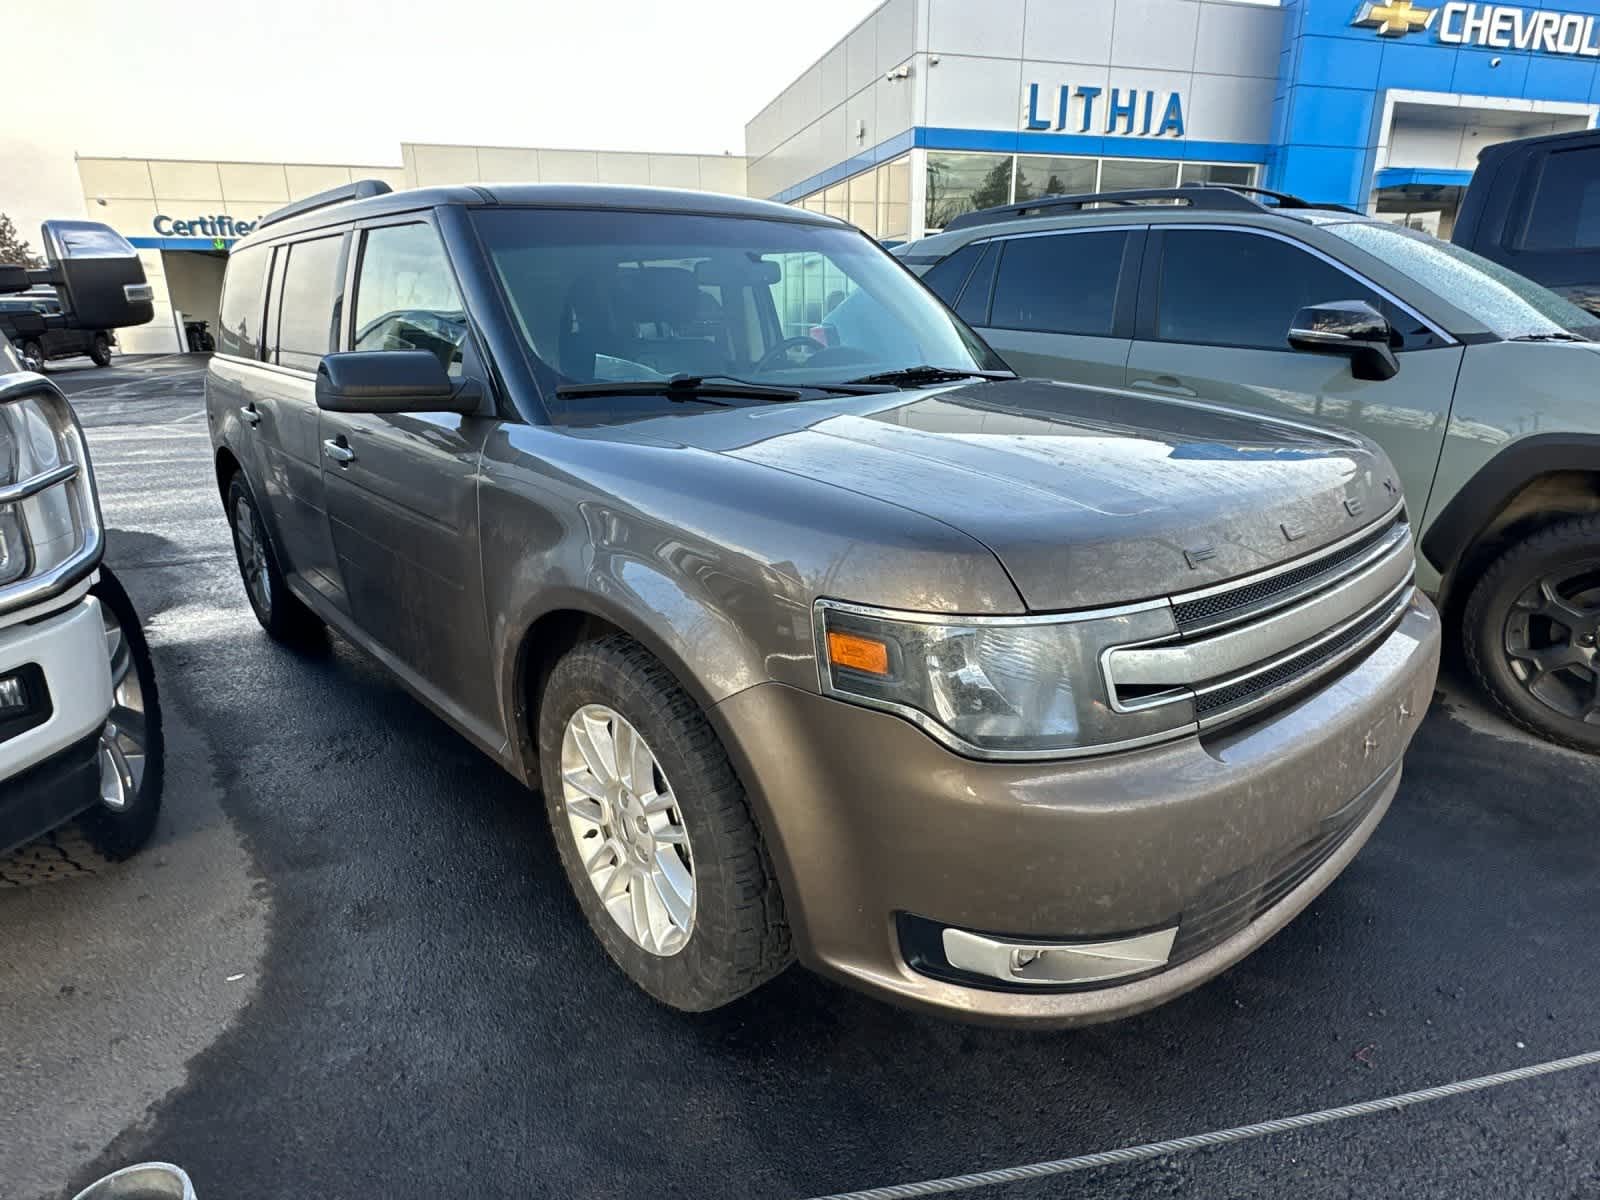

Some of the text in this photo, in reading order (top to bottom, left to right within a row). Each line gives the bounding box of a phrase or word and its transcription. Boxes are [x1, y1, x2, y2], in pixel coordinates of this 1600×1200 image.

[1439, 3, 1600, 56] CHEVROL
[1026, 83, 1185, 137] LITHIA
[1183, 478, 1397, 570] FLEX
